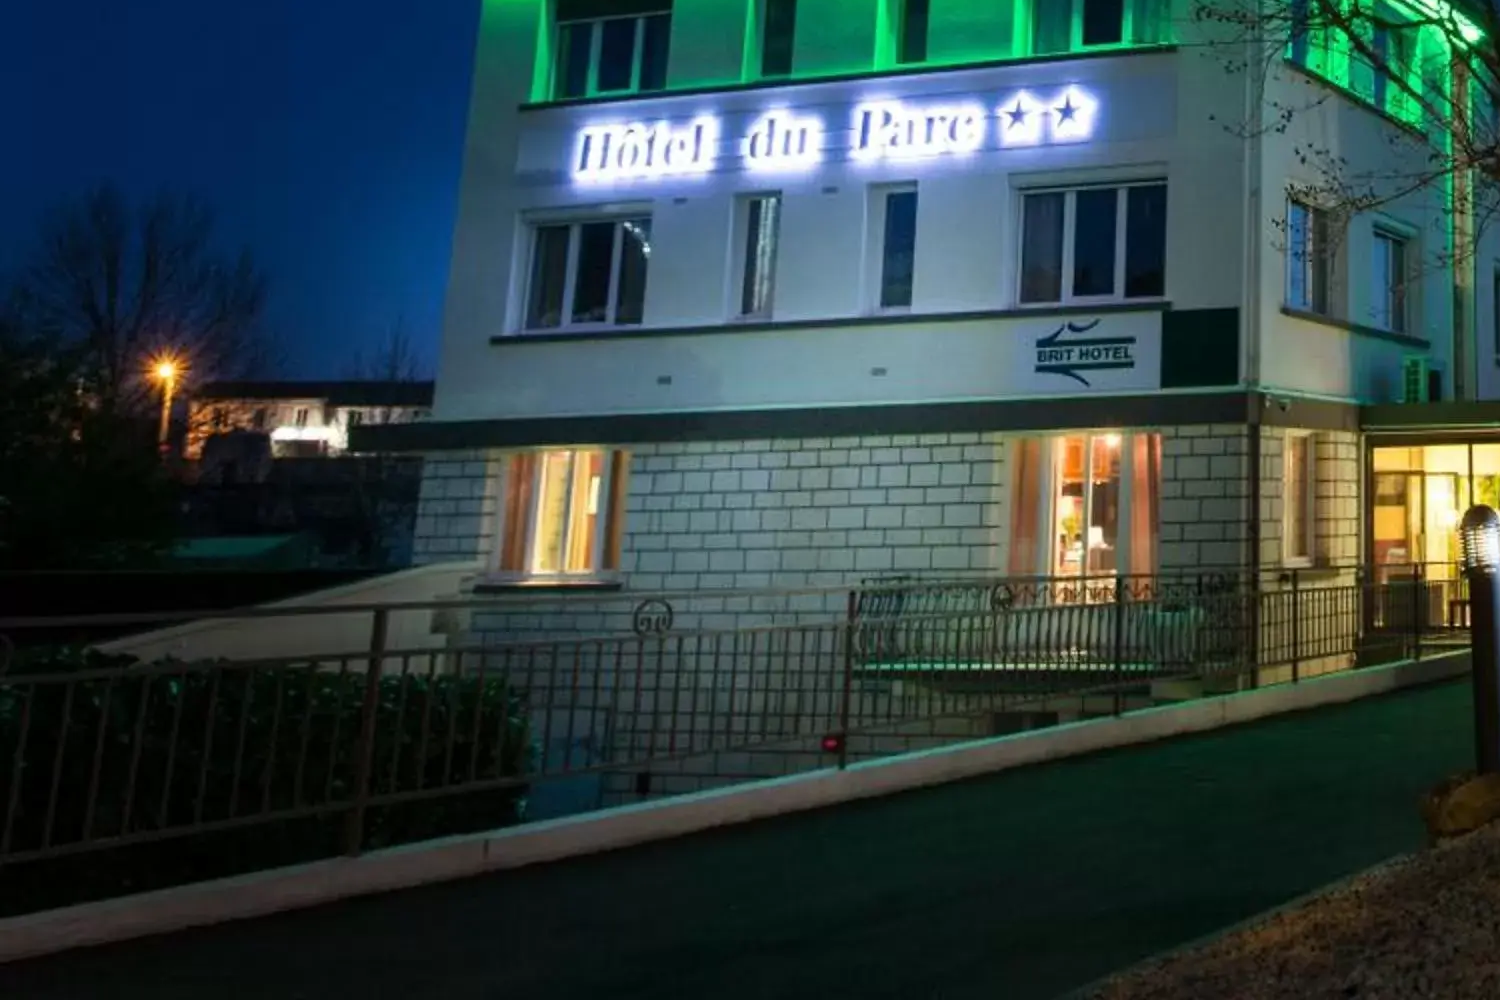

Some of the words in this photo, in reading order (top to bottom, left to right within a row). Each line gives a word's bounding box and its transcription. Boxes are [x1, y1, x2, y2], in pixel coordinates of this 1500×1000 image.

[576, 120, 709, 175] Hôtel
[746, 112, 813, 161] du
[856, 105, 978, 155] Parc
[1036, 348, 1075, 363] BRIT
[1078, 345, 1133, 361] HOTEL
